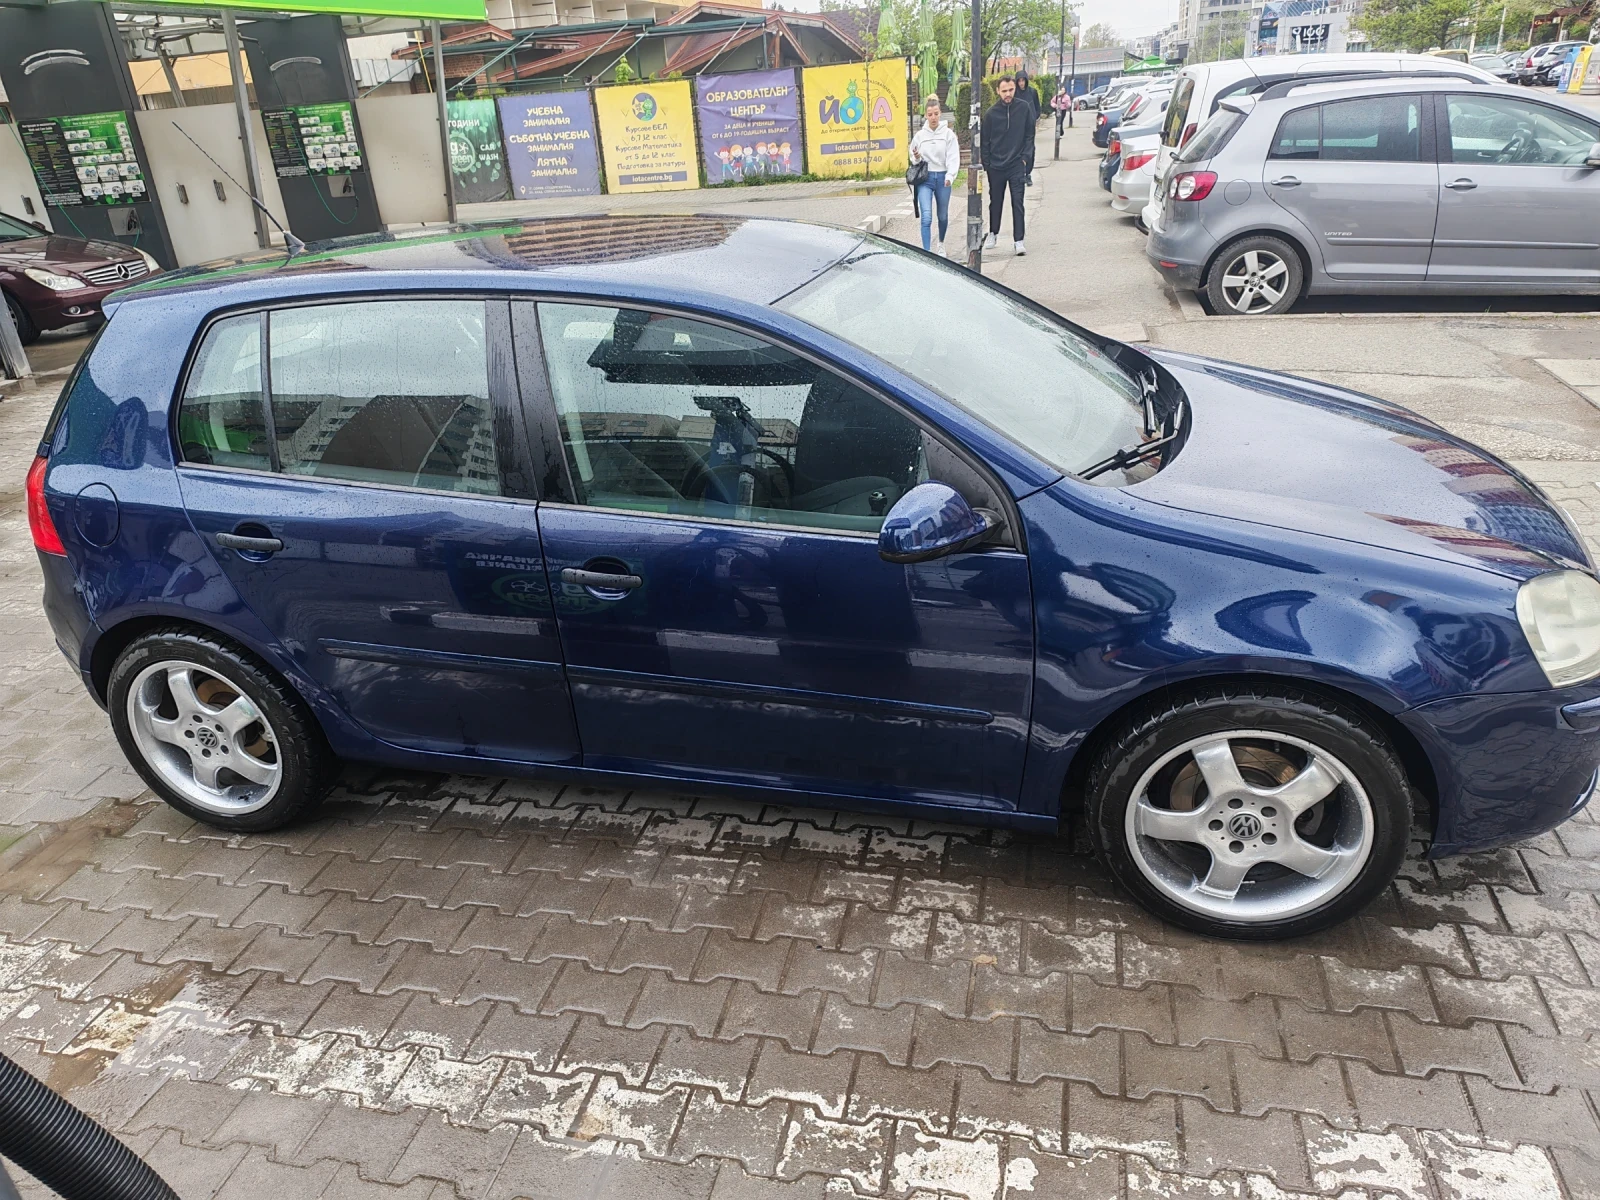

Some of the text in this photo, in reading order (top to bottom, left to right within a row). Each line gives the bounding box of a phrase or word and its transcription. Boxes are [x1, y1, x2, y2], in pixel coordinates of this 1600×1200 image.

[706, 86, 788, 103] ОБРАЗОВАТЕЛЕН
[527, 106, 563, 116] УЧЕБНА
[730, 104, 766, 117] ЦЕНТЪР
[448, 119, 480, 128] ГОДИНИ
[523, 117, 570, 127] ЗАНИМАЛНЯ
[652, 123, 667, 131] БЕЛ
[510, 130, 590, 143] СЪБОТНА УЧЕБНА
[527, 143, 574, 152] ЗАНИМАЛНЯ
[642, 142, 682, 150] Математика
[479, 153, 499, 161] WASH
[537, 157, 567, 166] ЛЯТНА
[867, 155, 882, 163] 740
[617, 162, 653, 170] Подготовка
[531, 168, 577, 177] ЗАНИМАЛНЯ
[632, 174, 672, 183] iotacentre.bg
